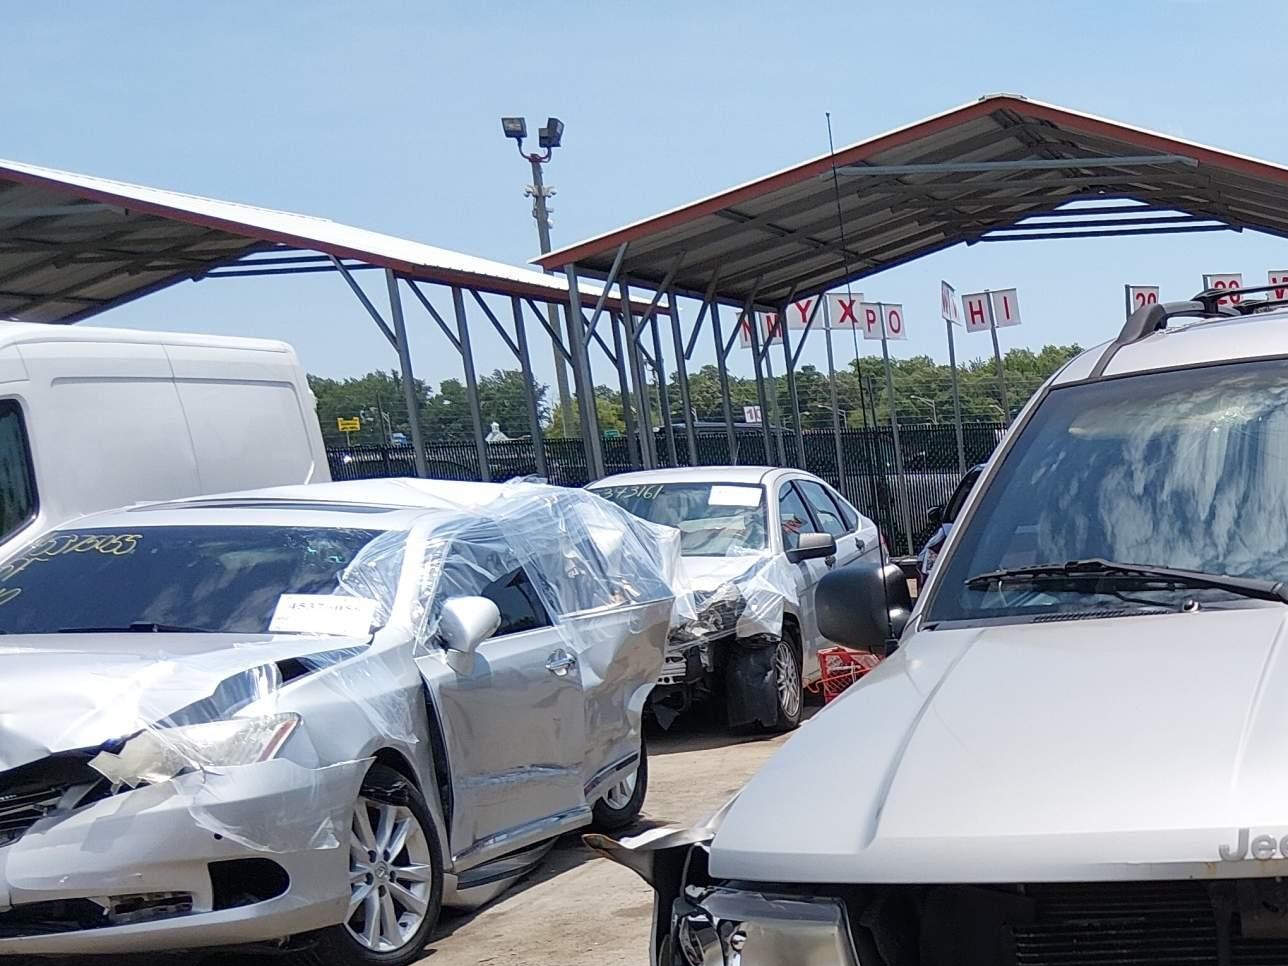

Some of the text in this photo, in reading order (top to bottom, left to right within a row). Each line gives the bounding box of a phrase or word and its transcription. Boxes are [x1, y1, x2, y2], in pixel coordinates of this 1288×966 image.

[795, 299, 813, 323] Y
[837, 299, 859, 324] X
[968, 298, 986, 325] H
[1003, 295, 1010, 320] I
[865, 309, 877, 333] P
[888, 310, 901, 334] O
